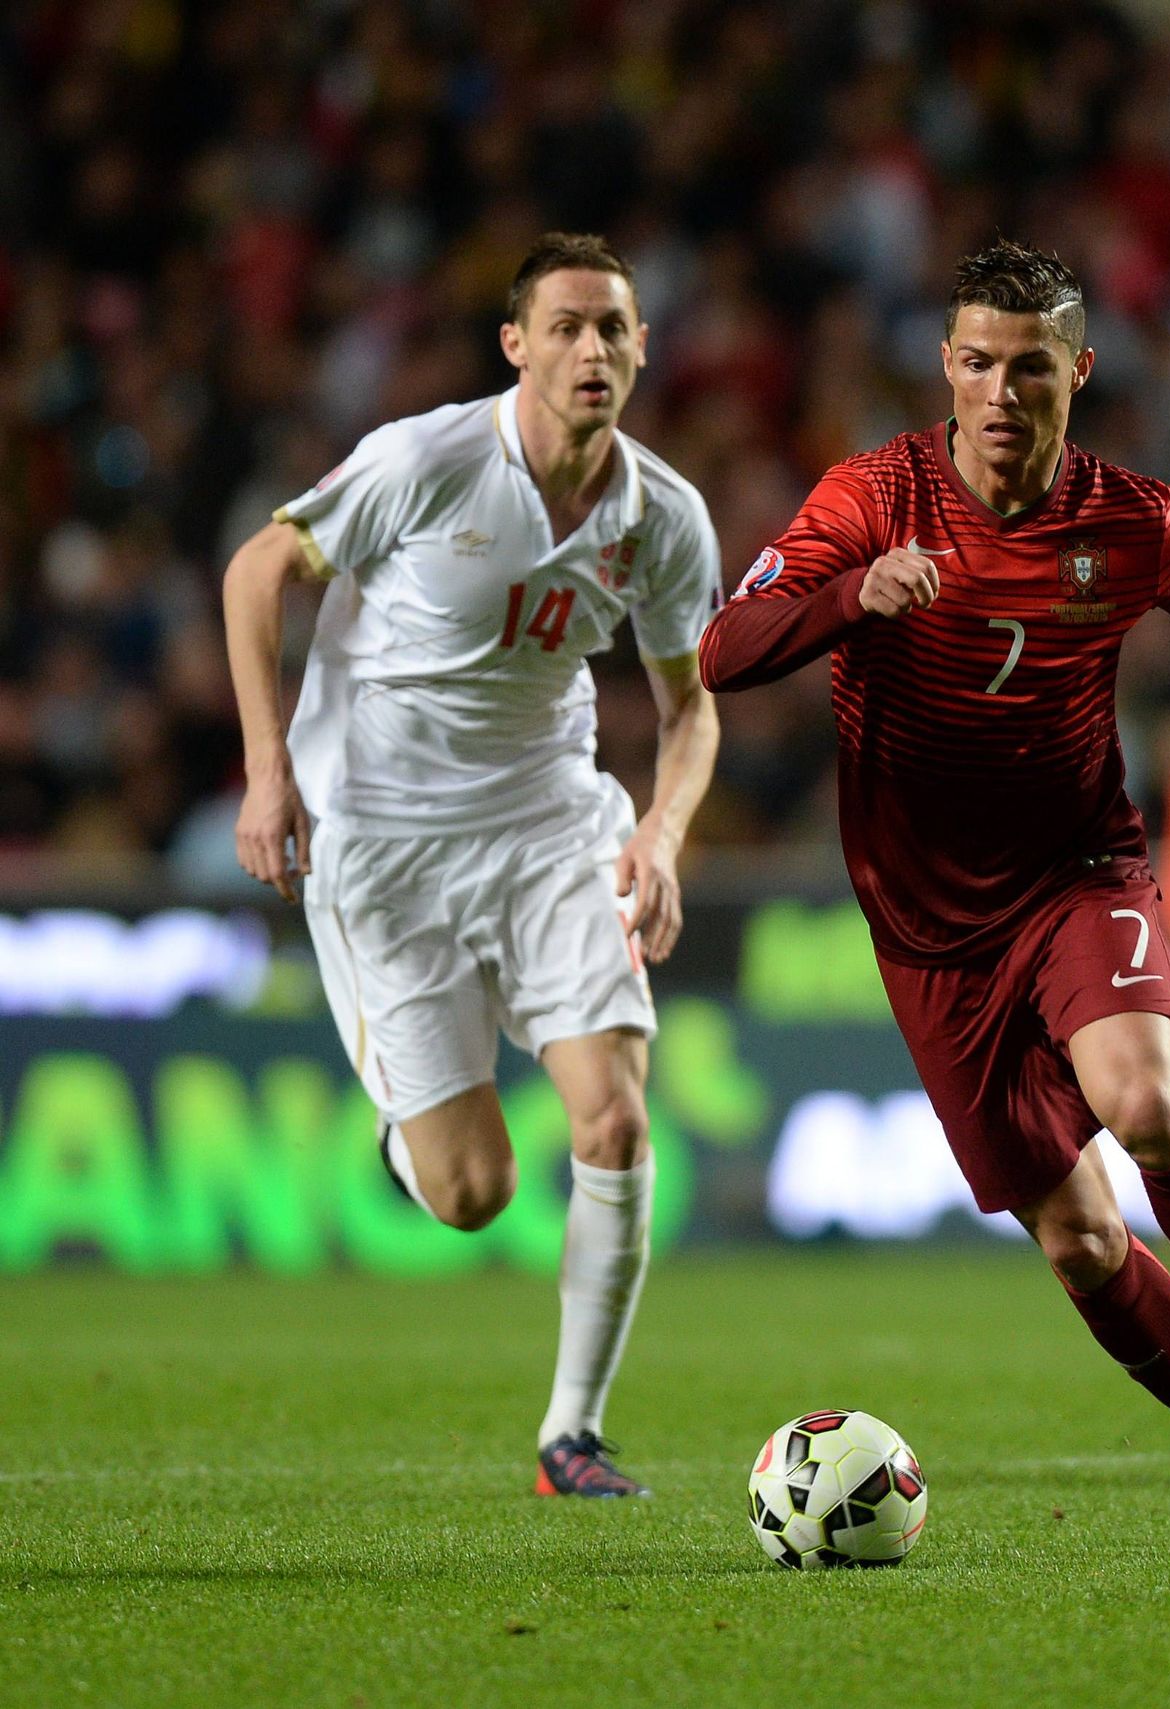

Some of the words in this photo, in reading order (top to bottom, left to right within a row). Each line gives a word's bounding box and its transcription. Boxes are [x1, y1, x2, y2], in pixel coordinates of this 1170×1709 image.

[500, 582, 577, 652] 14
[985, 618, 1026, 695] 7
[1110, 908, 1149, 969] 7
